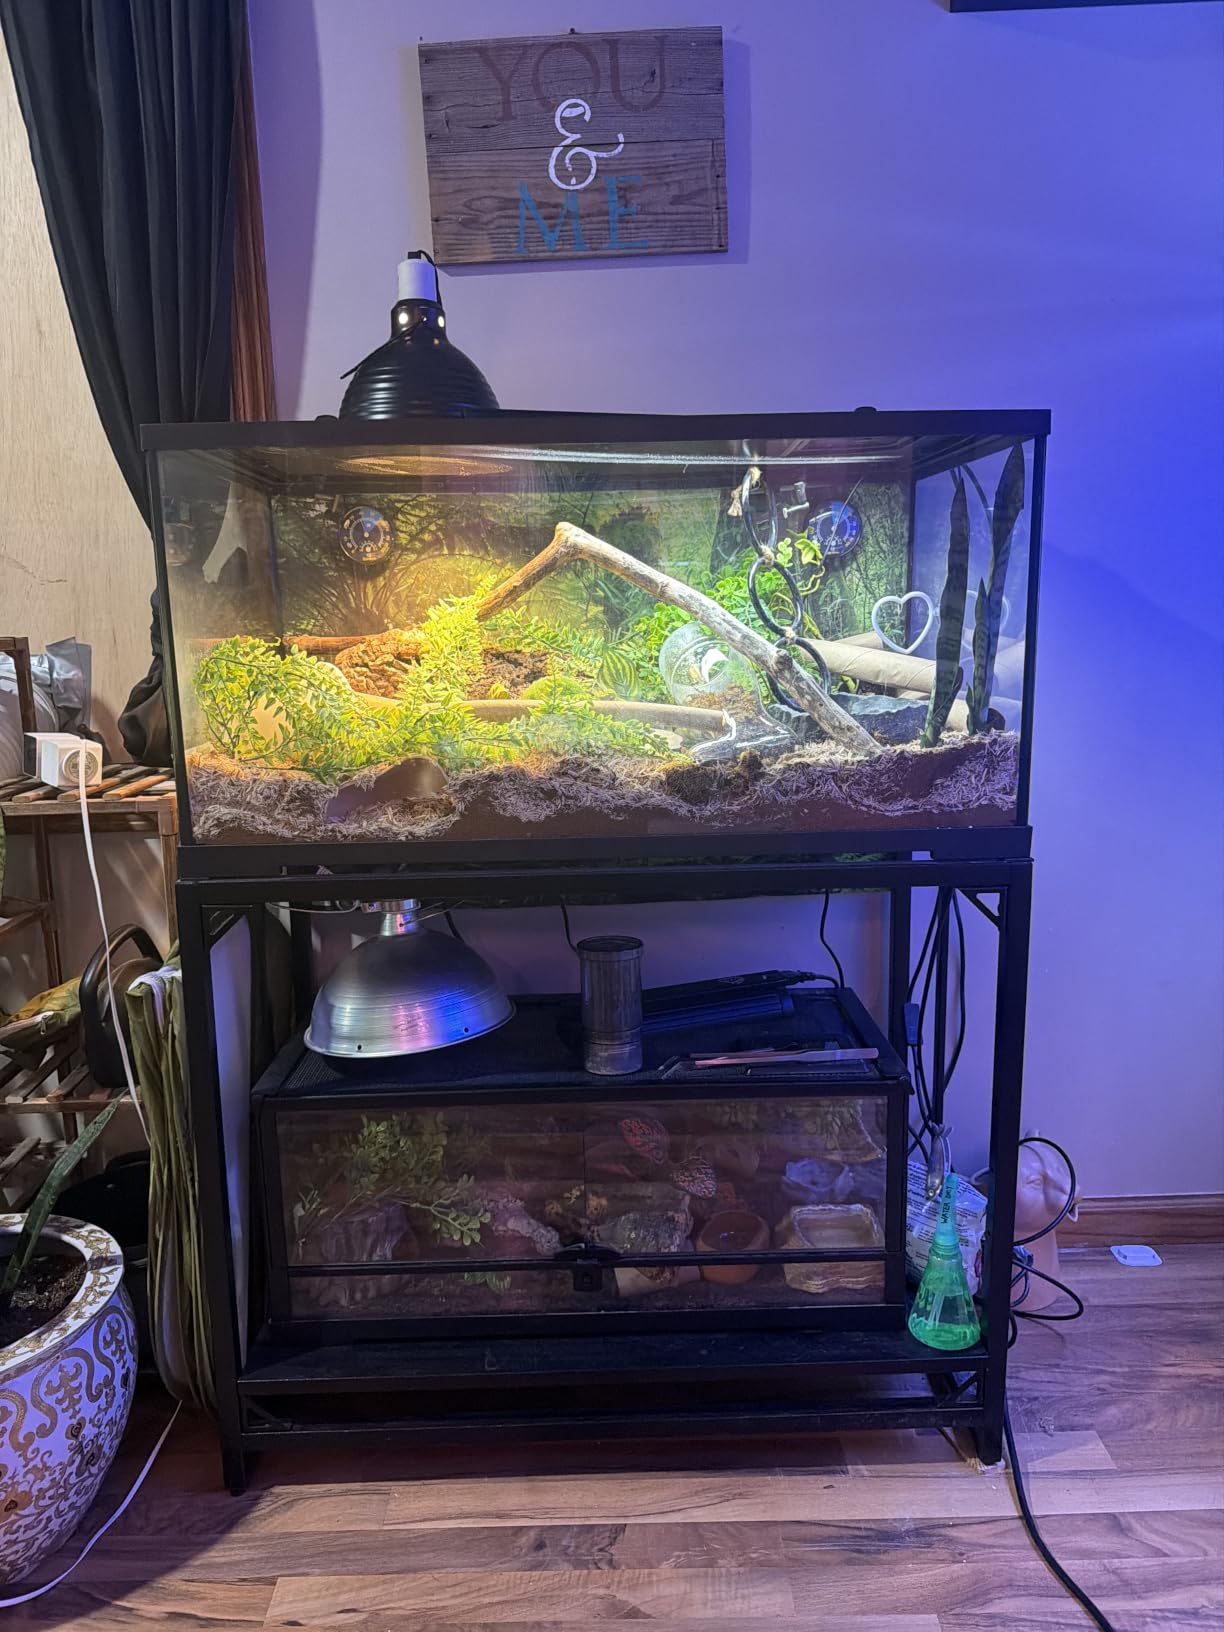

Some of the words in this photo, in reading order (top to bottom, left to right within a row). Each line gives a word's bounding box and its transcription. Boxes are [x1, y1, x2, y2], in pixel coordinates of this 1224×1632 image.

[474, 36, 671, 121] YOU
[548, 98, 625, 190] &
[514, 175, 650, 256] ME
